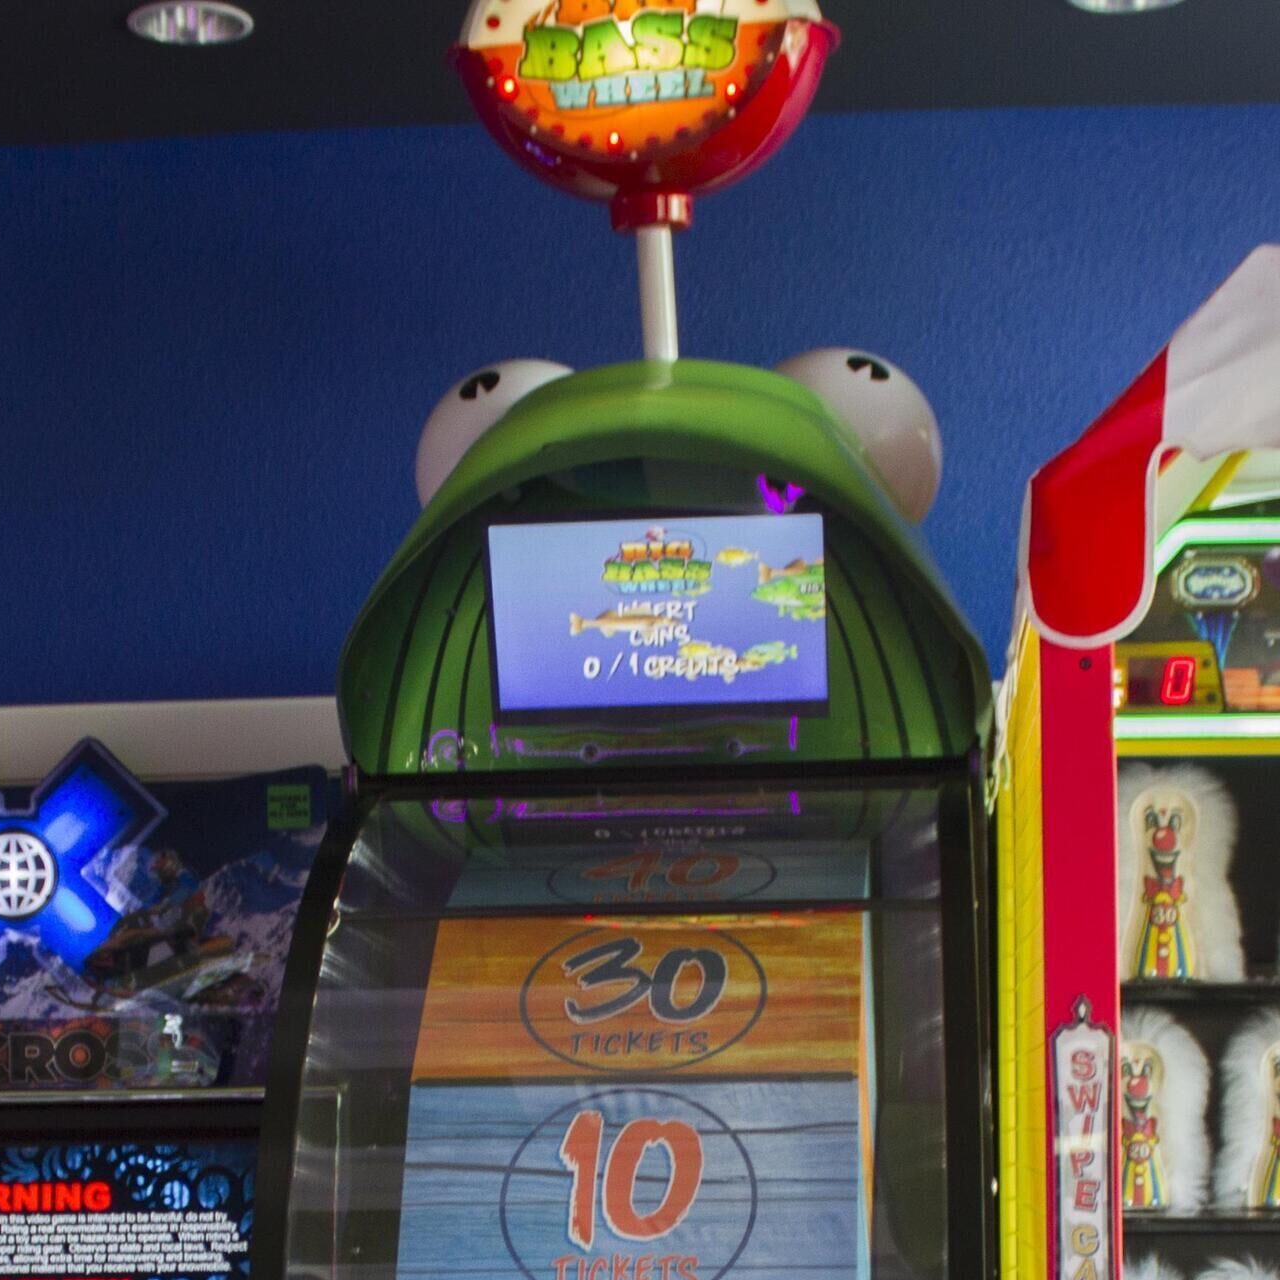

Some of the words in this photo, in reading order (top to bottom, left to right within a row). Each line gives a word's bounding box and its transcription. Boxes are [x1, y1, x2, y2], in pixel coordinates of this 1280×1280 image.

[519, 12, 739, 81] BASS
[602, 558, 713, 582] BASS
[583, 656, 601, 679] 0
[628, 654, 639, 676] 1
[1161, 656, 1196, 705] 0
[1151, 904, 1179, 926] 30
[562, 937, 728, 1025] 30
[571, 1030, 710, 1058] TICKETS
[1067, 1049, 1103, 1212] SWIPE
[558, 1110, 705, 1251] 10
